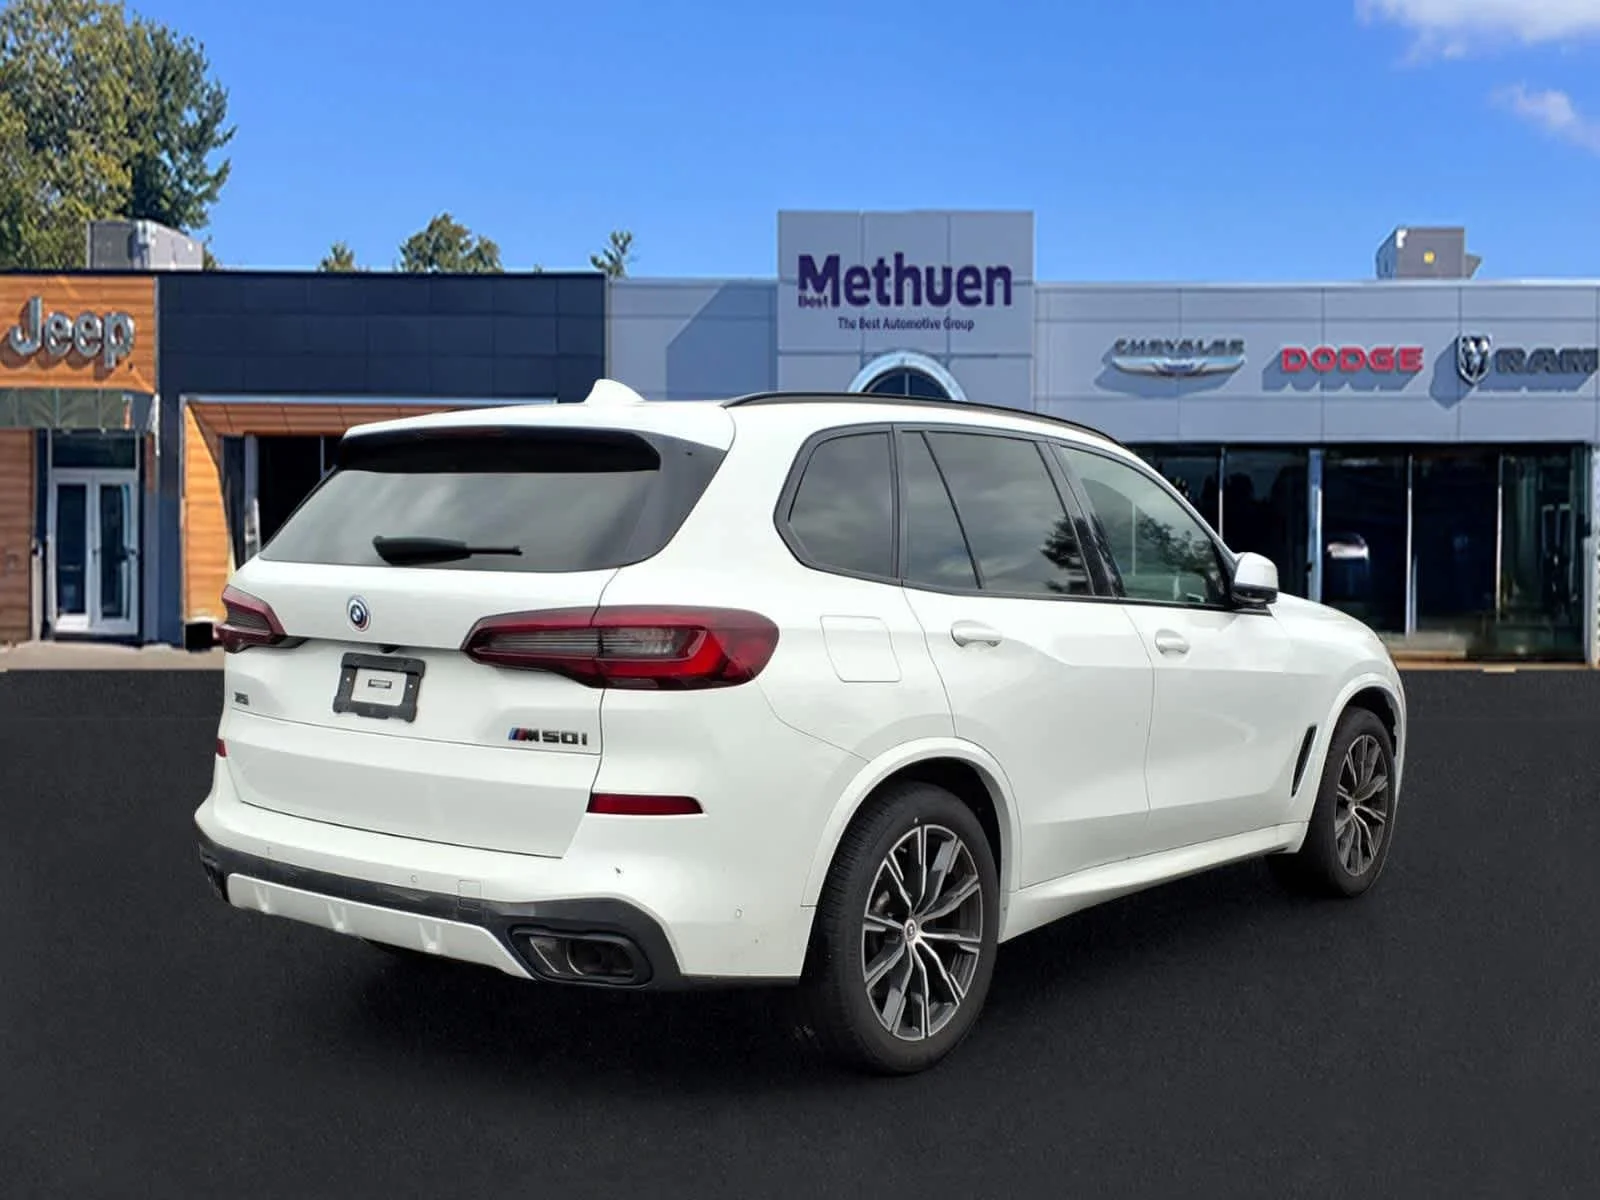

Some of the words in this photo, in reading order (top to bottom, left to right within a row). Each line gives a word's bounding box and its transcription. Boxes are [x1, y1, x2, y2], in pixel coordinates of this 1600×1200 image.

[798, 252, 1012, 307] Methuen
[9, 295, 136, 369] Jeep
[838, 317, 857, 329] The
[859, 317, 880, 329] Best
[883, 317, 941, 330] Automotive
[943, 316, 975, 332] Group
[1282, 346, 1424, 372] DODGE
[1494, 347, 1599, 374] RAM
